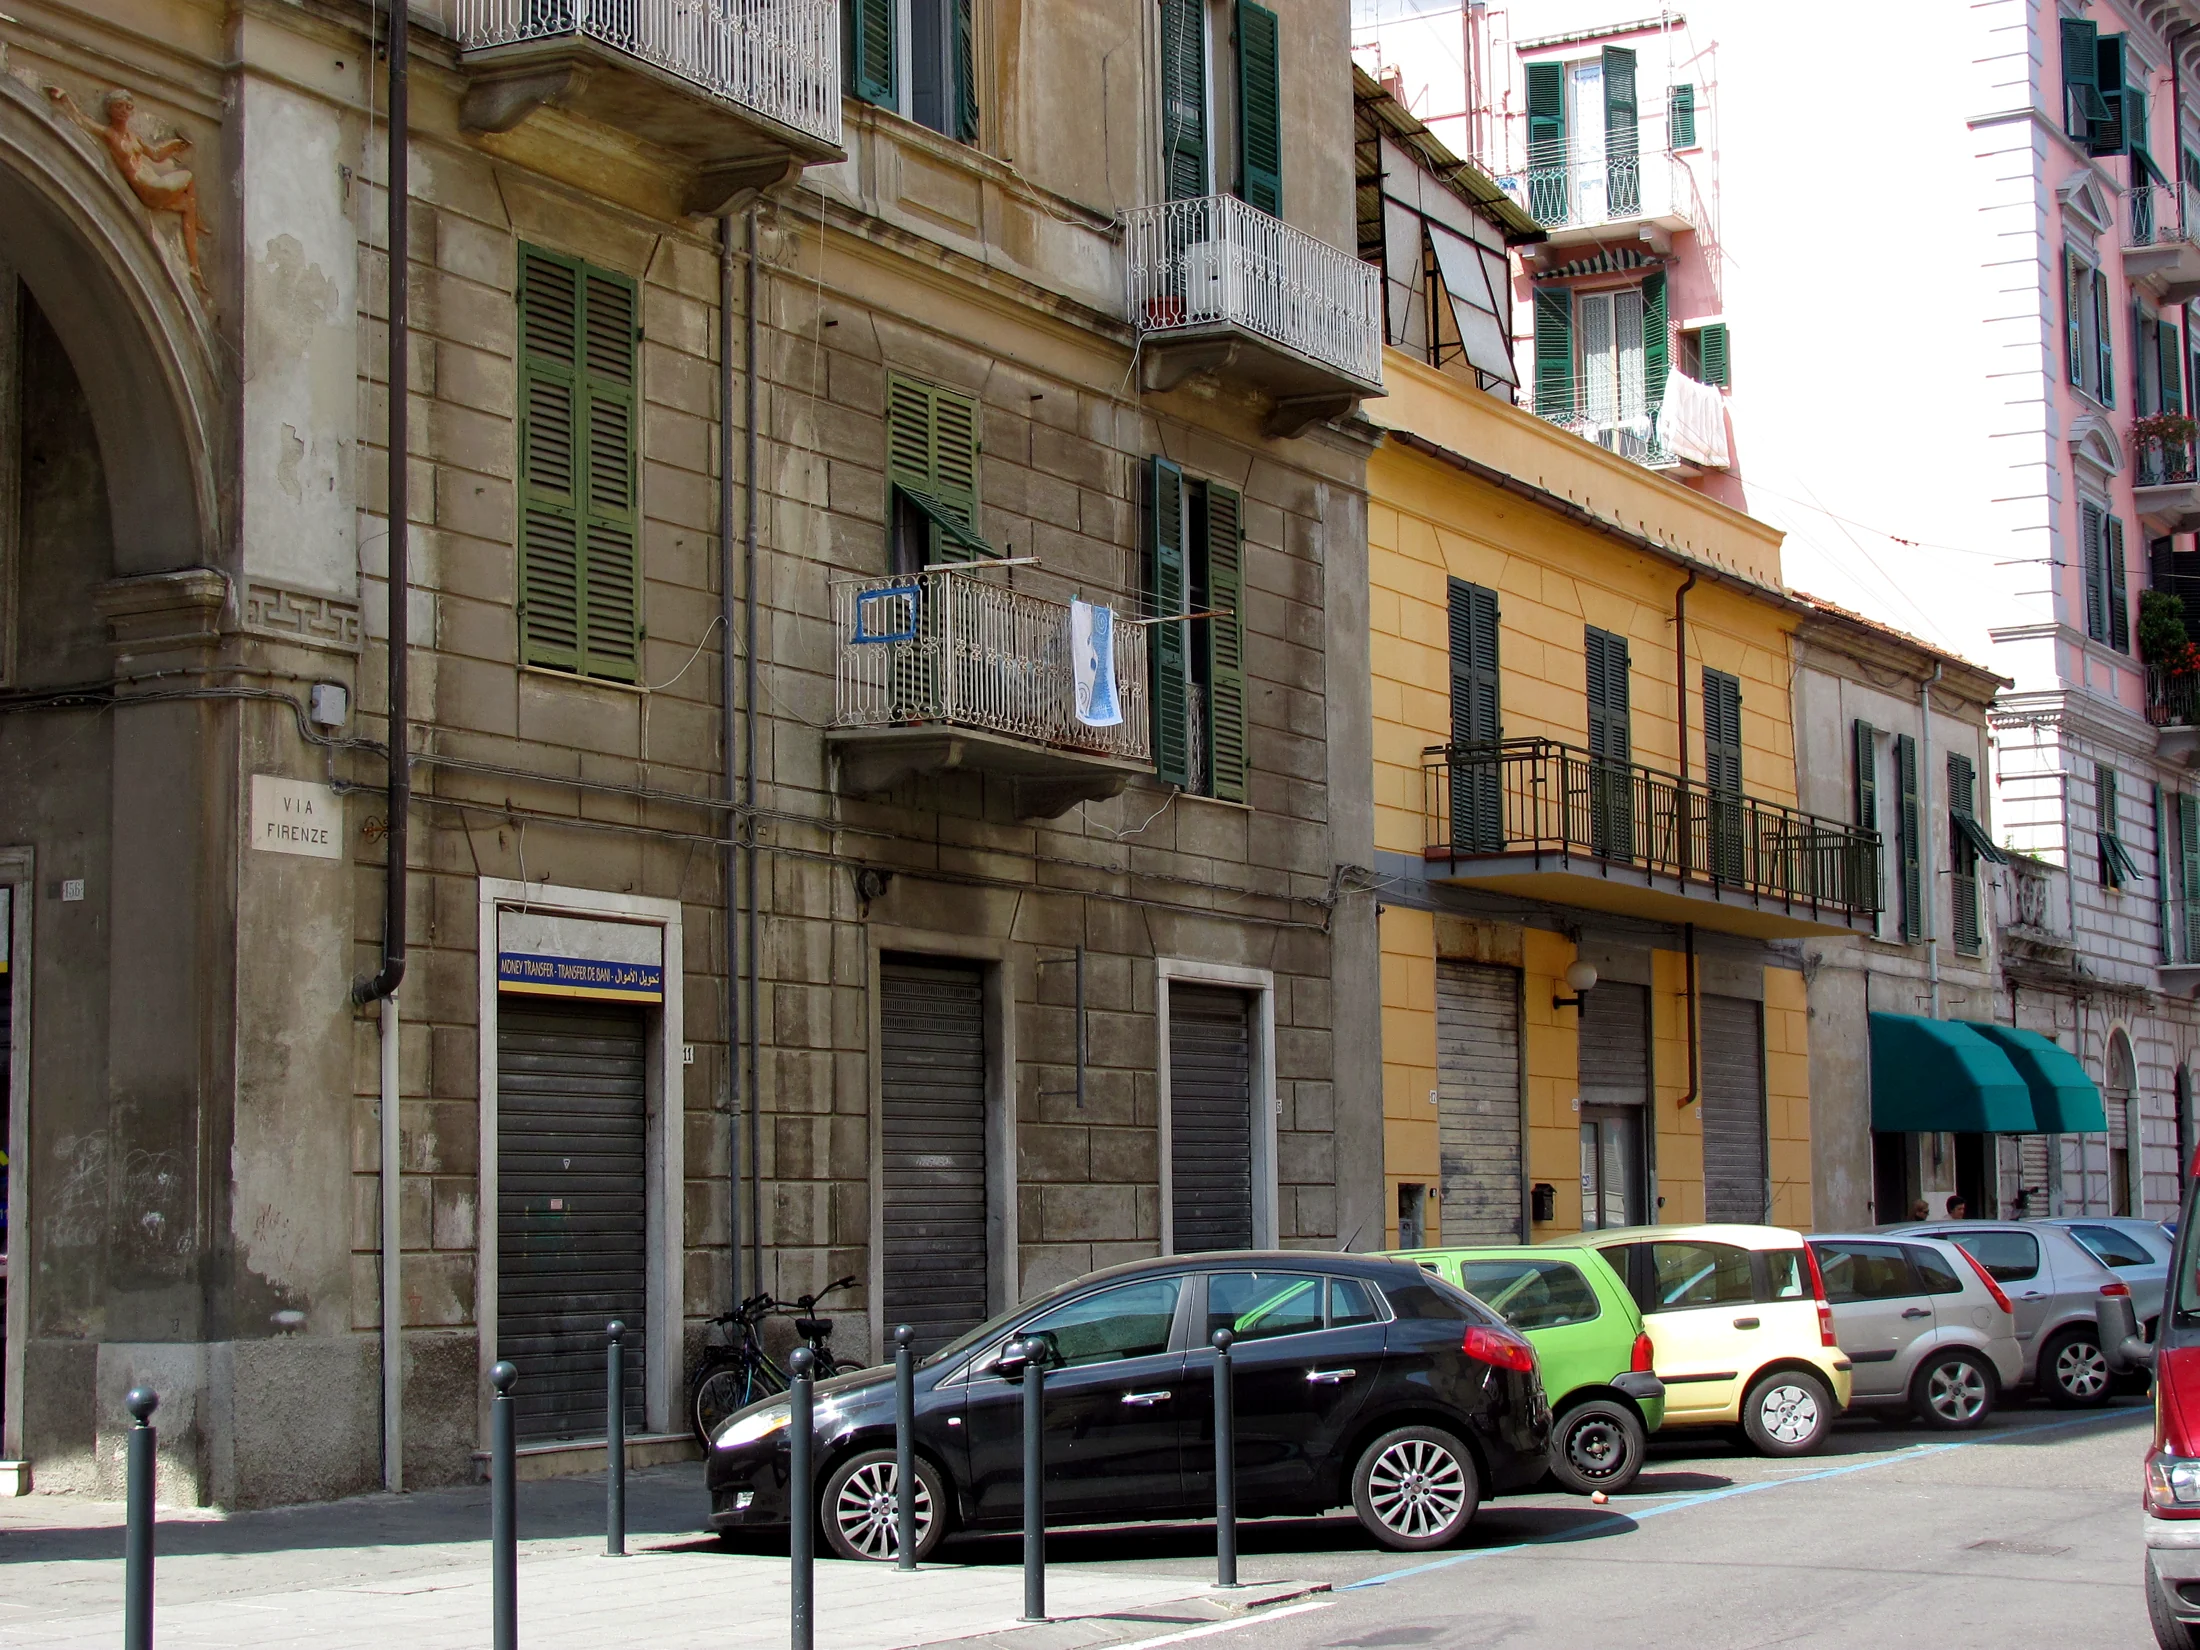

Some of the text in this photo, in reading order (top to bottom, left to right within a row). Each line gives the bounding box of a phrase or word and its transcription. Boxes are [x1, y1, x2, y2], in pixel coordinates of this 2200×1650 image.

[283, 797, 313, 815] VIA
[267, 823, 329, 845] FIRENZE
[65, 882, 81, 898] 156
[501, 959, 523, 975] MONEY
[524, 960, 554, 978] TRANSFER
[558, 964, 587, 980] TRANSFER
[588, 966, 595, 982] DE
[596, 967, 611, 983] BANI
[684, 1047, 691, 1061] 11
